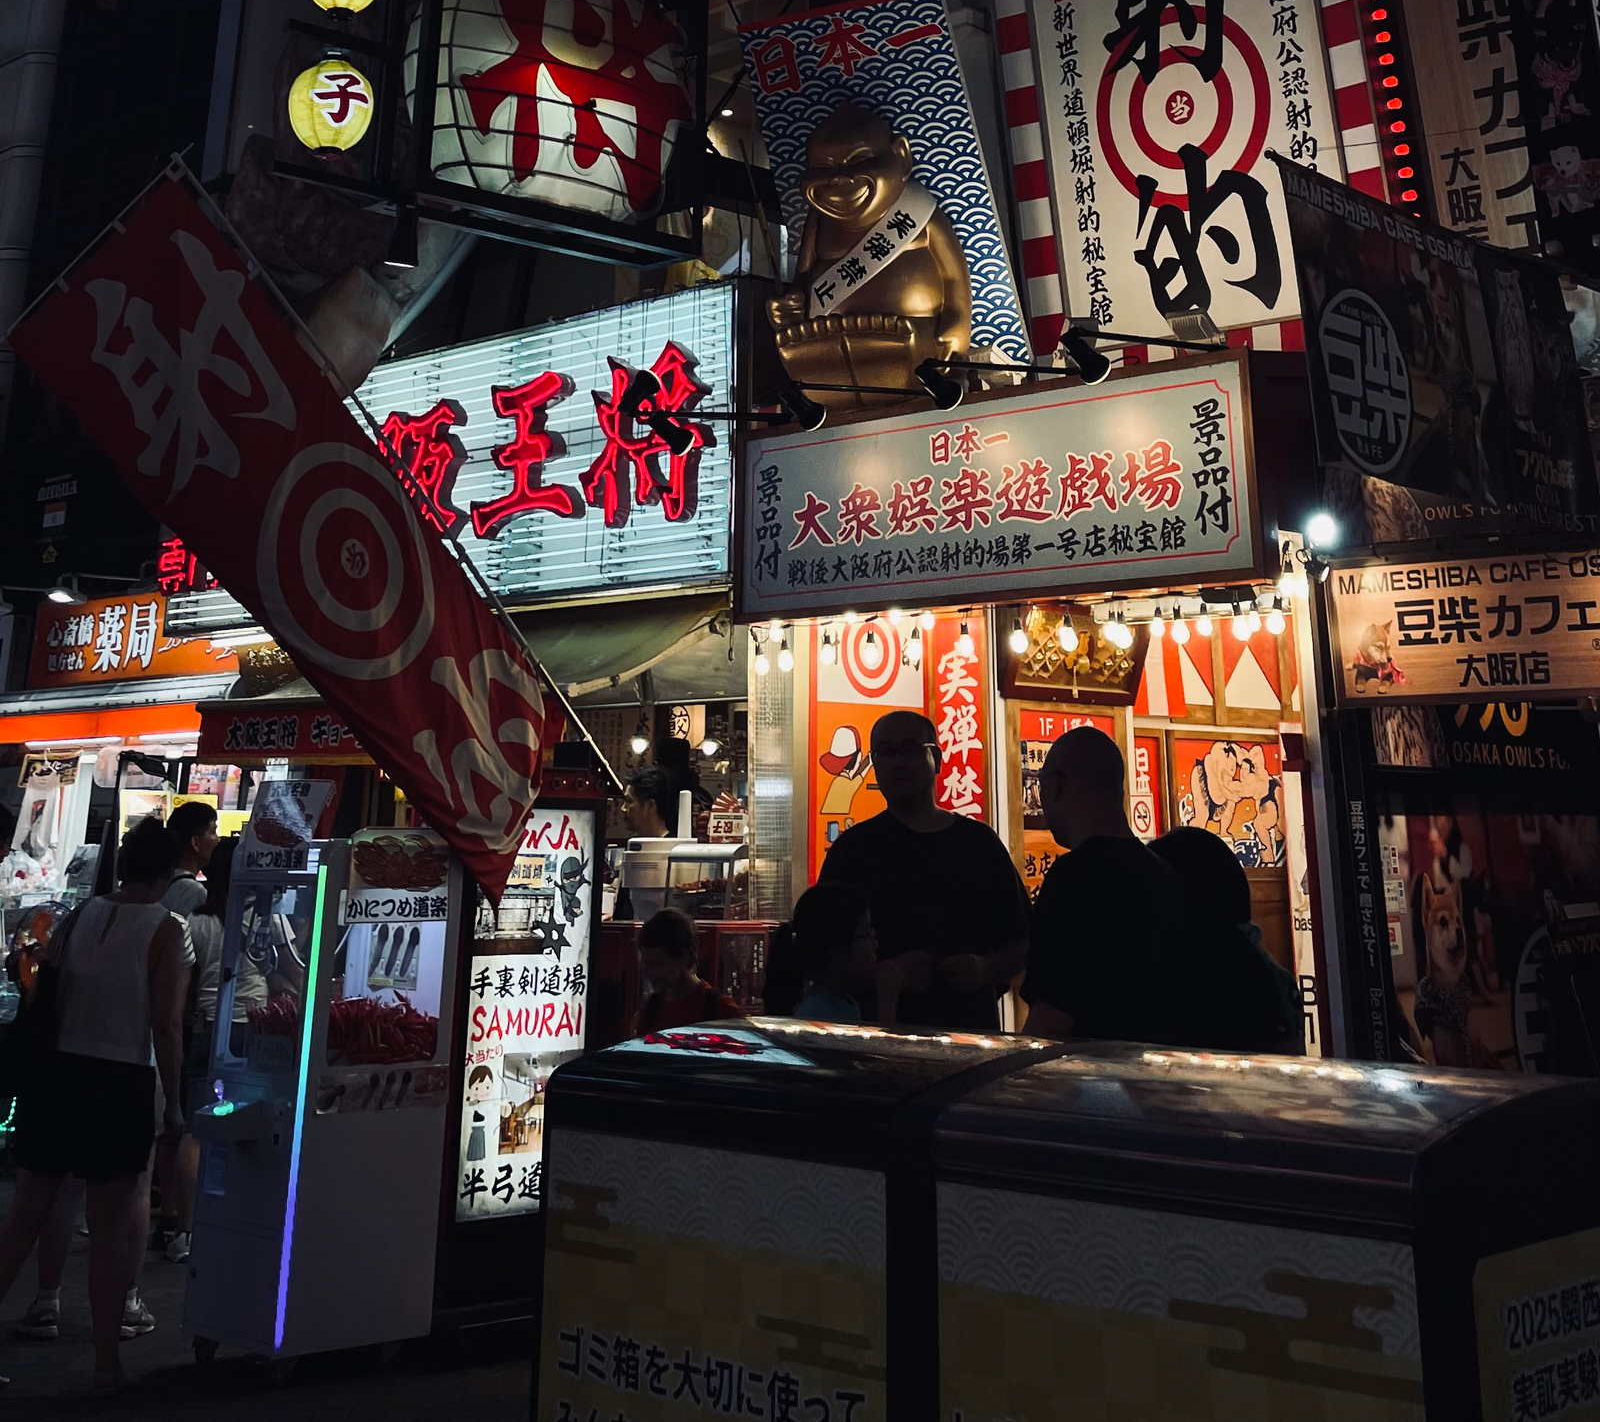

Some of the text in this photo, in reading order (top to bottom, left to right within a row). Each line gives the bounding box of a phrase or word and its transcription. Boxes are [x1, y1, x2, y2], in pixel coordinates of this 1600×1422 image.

[754, 16, 943, 95] 日本一
[1286, 172, 1473, 271] MAMESHIBA CAFE OSAKA
[929, 424, 1010, 466] 日本一
[1189, 398, 1231, 535] 景品付
[788, 441, 1183, 551] 大衆娯楽遊戯場
[755, 464, 783, 582] 景品付
[1339, 564, 1483, 596] MAMESHIBA
[1489, 558, 1561, 584] CAFE
[46, 614, 95, 648] 心斎橋
[92, 600, 159, 673] 薬局
[1456, 651, 1551, 688] 大阪店
[224, 715, 299, 751] 大阪王将
[1452, 741, 1501, 766] OSAKA
[1504, 745, 1546, 769] OWL'S
[347, 895, 448, 919] かにつめ道楽
[470, 963, 586, 999] 手裏剣道場
[471, 1002, 583, 1042] SAMURAI
[465, 1043, 505, 1067] 大当たり
